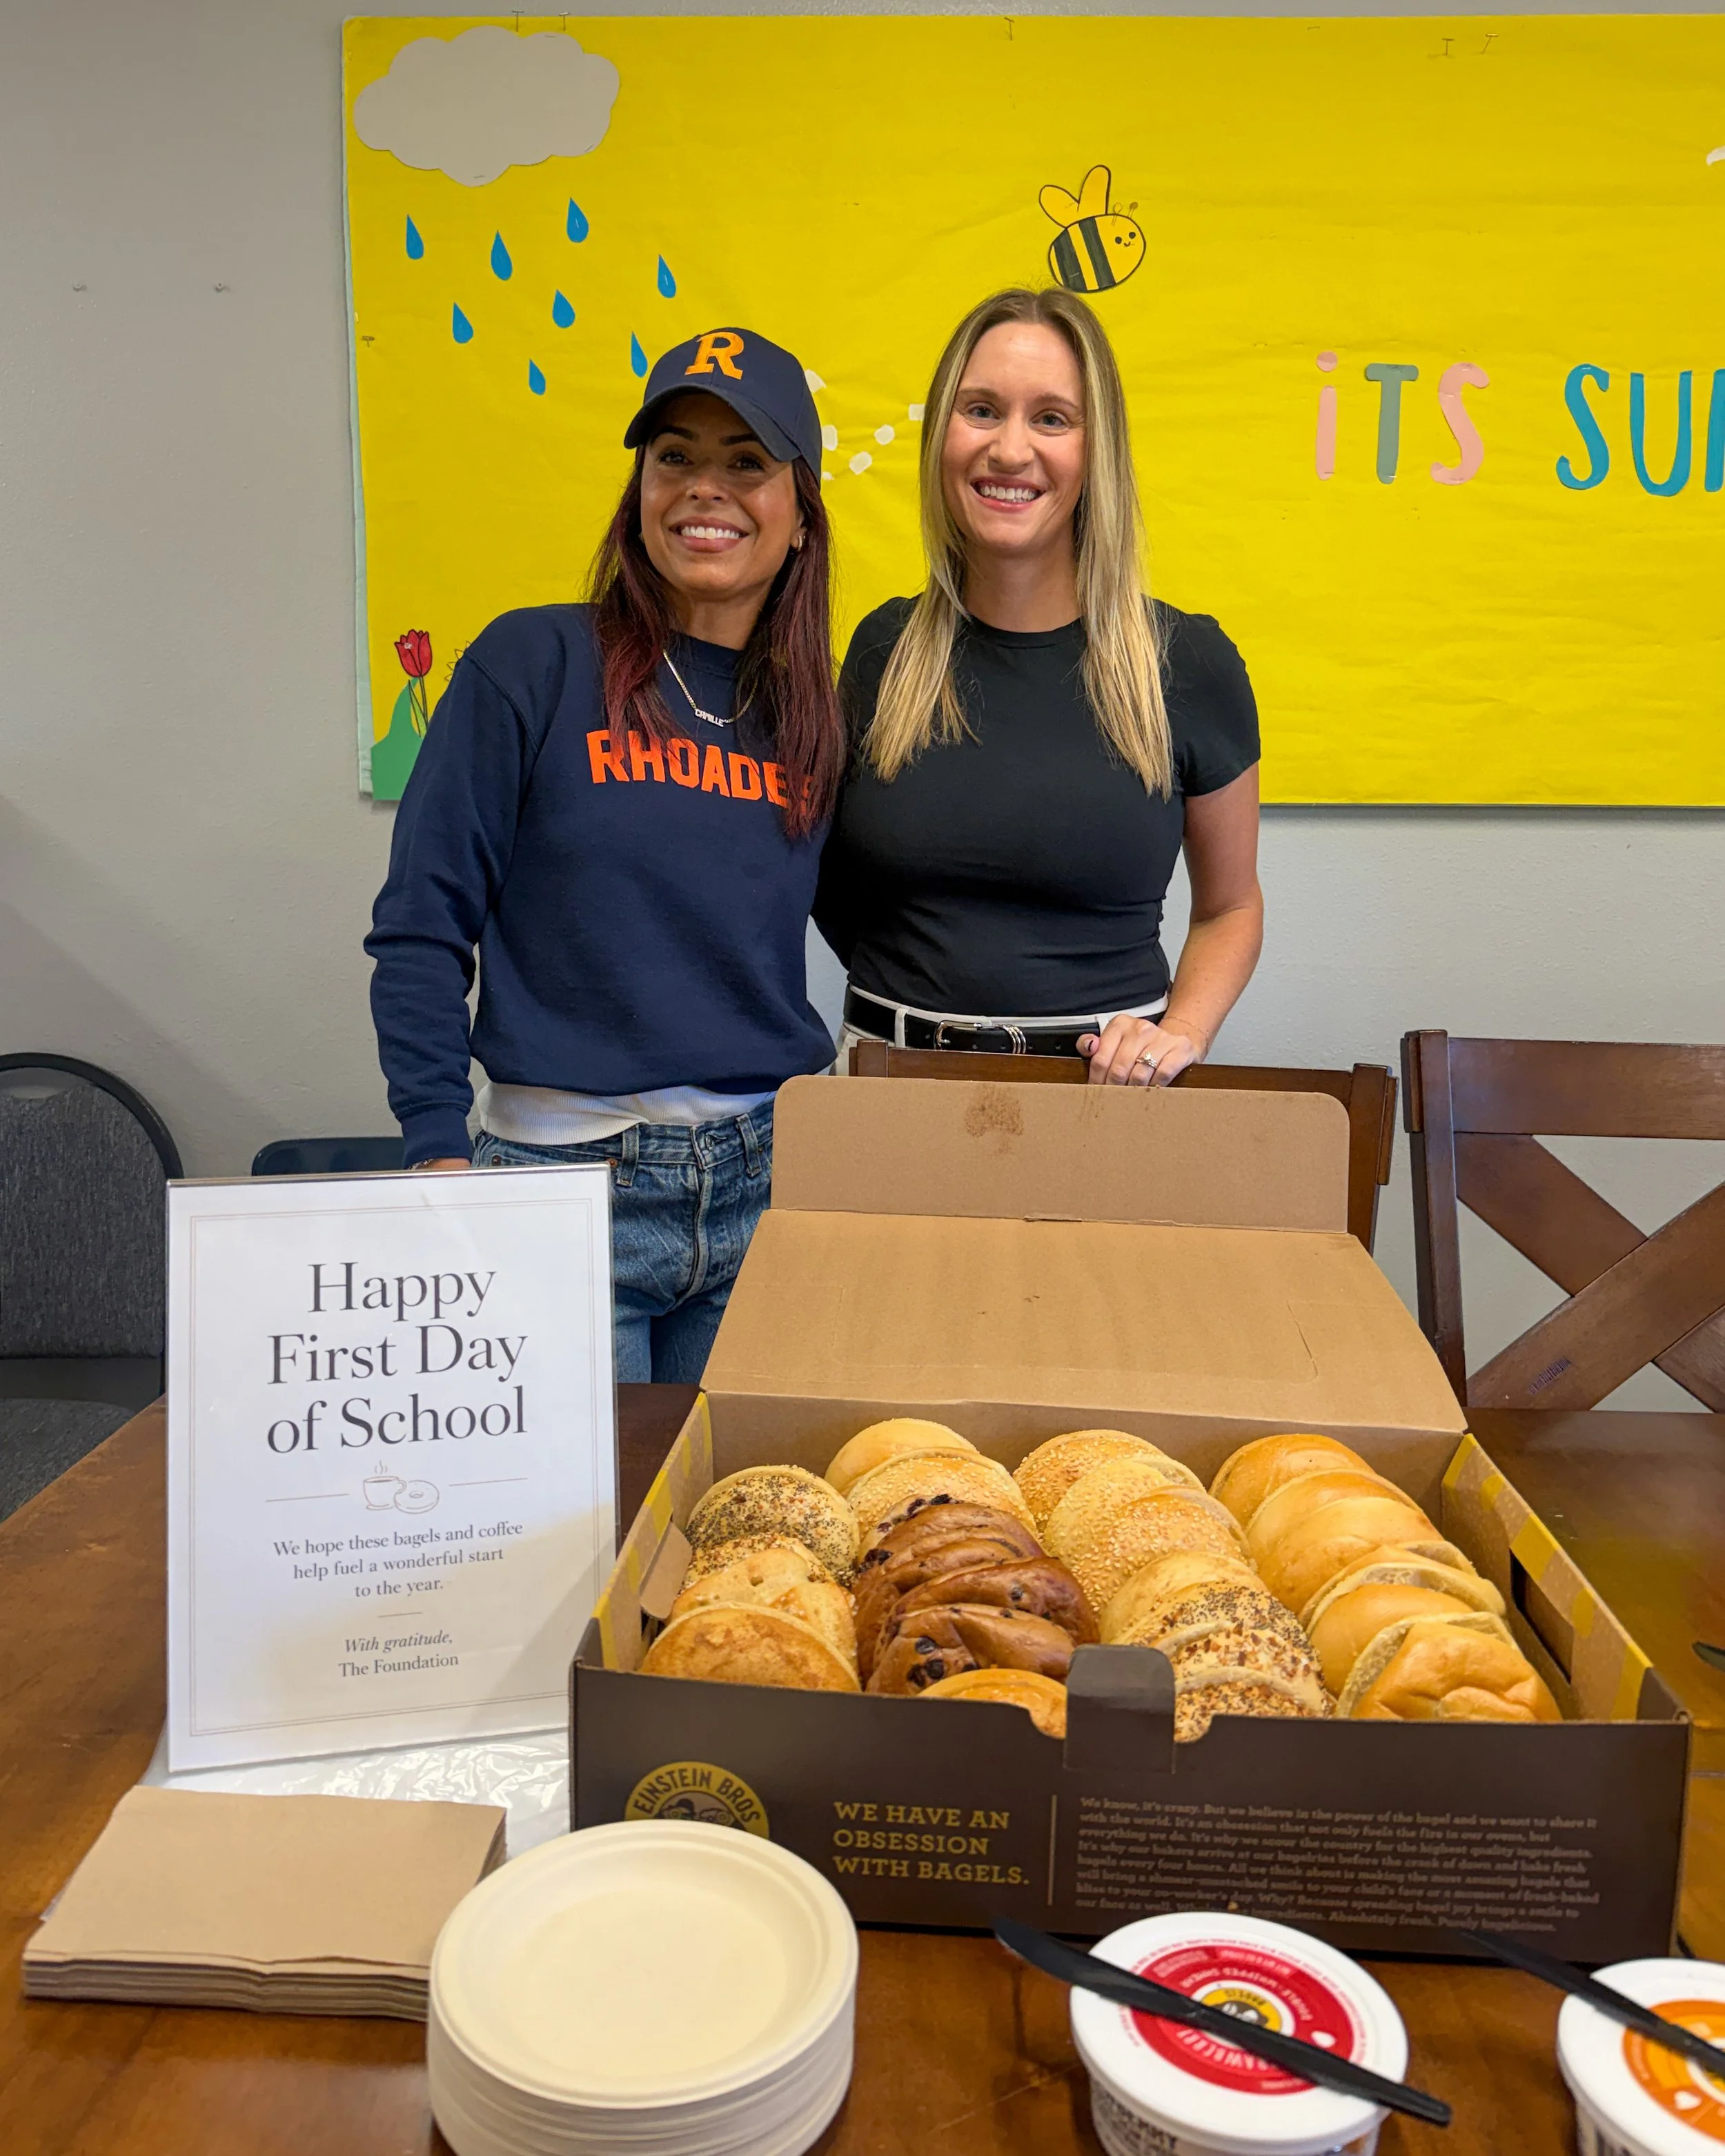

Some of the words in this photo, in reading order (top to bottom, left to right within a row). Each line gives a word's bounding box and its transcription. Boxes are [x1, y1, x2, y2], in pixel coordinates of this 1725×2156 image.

[684, 332, 744, 380] R
[586, 730, 814, 815] RHOADE
[308, 1262, 497, 1322] Happy
[268, 1334, 397, 1384] First
[415, 1325, 528, 1382] Day
[268, 1401, 327, 1453] of
[341, 1385, 527, 1447] School
[274, 1541, 300, 1556] We
[305, 1539, 344, 1556] hope
[348, 1534, 388, 1550] these
[393, 1528, 441, 1548] bagels
[446, 1525, 473, 1541] and
[478, 1521, 523, 1538] coffee
[293, 1564, 328, 1581] help
[334, 1559, 363, 1576] fuel
[369, 1563, 377, 1572] a
[384, 1550, 463, 1571] wonderful
[469, 1548, 504, 1563] start
[355, 1585, 371, 1597] to
[376, 1580, 402, 1596] the
[407, 1579, 444, 1596] year.
[345, 1637, 379, 1653] With
[383, 1630, 453, 1653] gratitude,
[338, 1662, 368, 1677] The
[373, 1654, 458, 1674] Foundation
[632, 1768, 713, 1814] EINSTEIN
[716, 1777, 762, 1822] BROS
[834, 1801, 878, 1821] WE
[885, 1804, 961, 1826] HAVE
[969, 1810, 1010, 1829] AN
[1080, 1797, 1101, 1808] We
[1103, 1798, 1140, 1811] know,
[1164, 1804, 1200, 1815] crazy.
[1203, 1803, 1225, 1814] But
[1248, 1806, 1293, 1818] believe
[1296, 1810, 1308, 1819] in
[1311, 1809, 1332, 1819] the
[1335, 1812, 1374, 1822] power
[1377, 1812, 1391, 1821] of
[1392, 1812, 1413, 1823] the
[1416, 1812, 1450, 1826] bagel
[1453, 1814, 1477, 1824] and
[1500, 1817, 1530, 1826] want
[1534, 1817, 1546, 1826] to
[1550, 1817, 1584, 1827] share
[1587, 1819, 1597, 1828] it
[833, 1829, 989, 1855] OBSESSION
[832, 1855, 910, 1877] WITH
[917, 1861, 1029, 1886] BAGELS.
